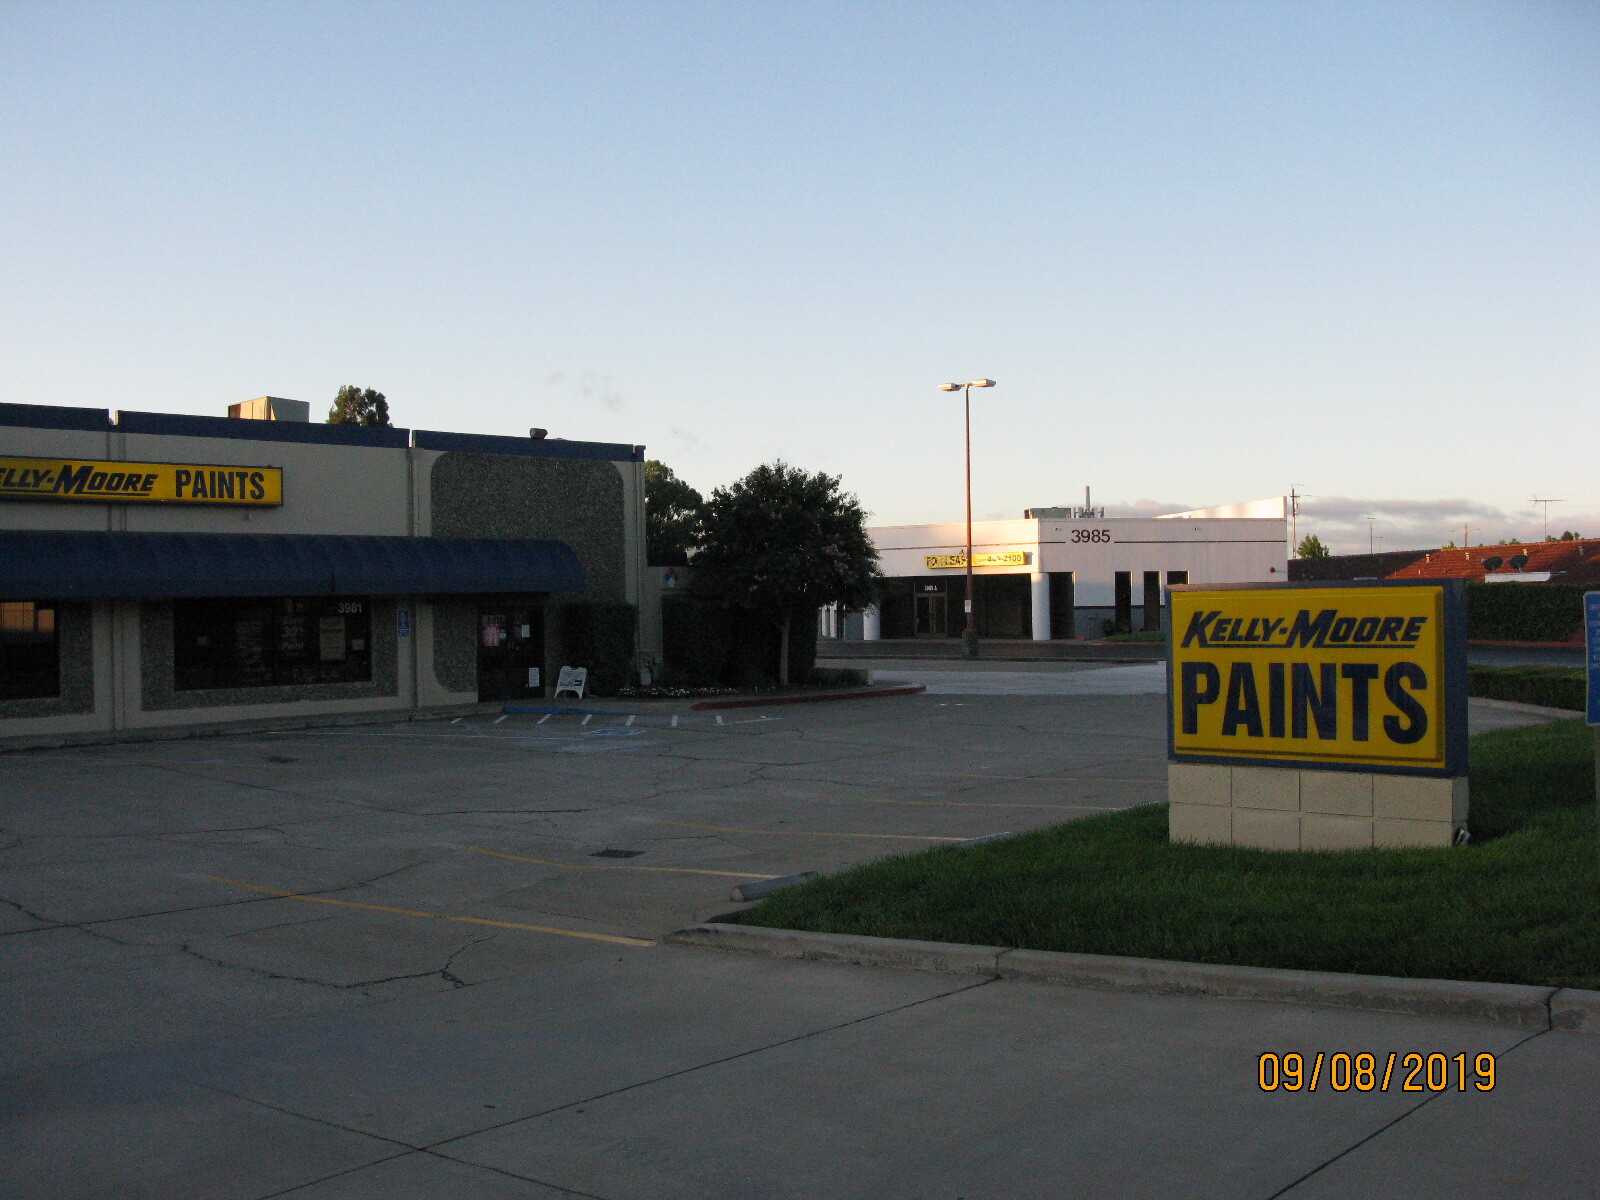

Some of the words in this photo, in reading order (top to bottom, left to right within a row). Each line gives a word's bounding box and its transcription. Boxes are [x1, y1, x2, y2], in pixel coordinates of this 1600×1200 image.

[175, 469, 266, 500] PAINTS
[1071, 529, 1111, 544] 3985
[926, 556, 942, 567] FO
[338, 602, 362, 614] 3981
[1180, 609, 1429, 649] KELLY-MOORE
[1181, 661, 1429, 745] PAINTS
